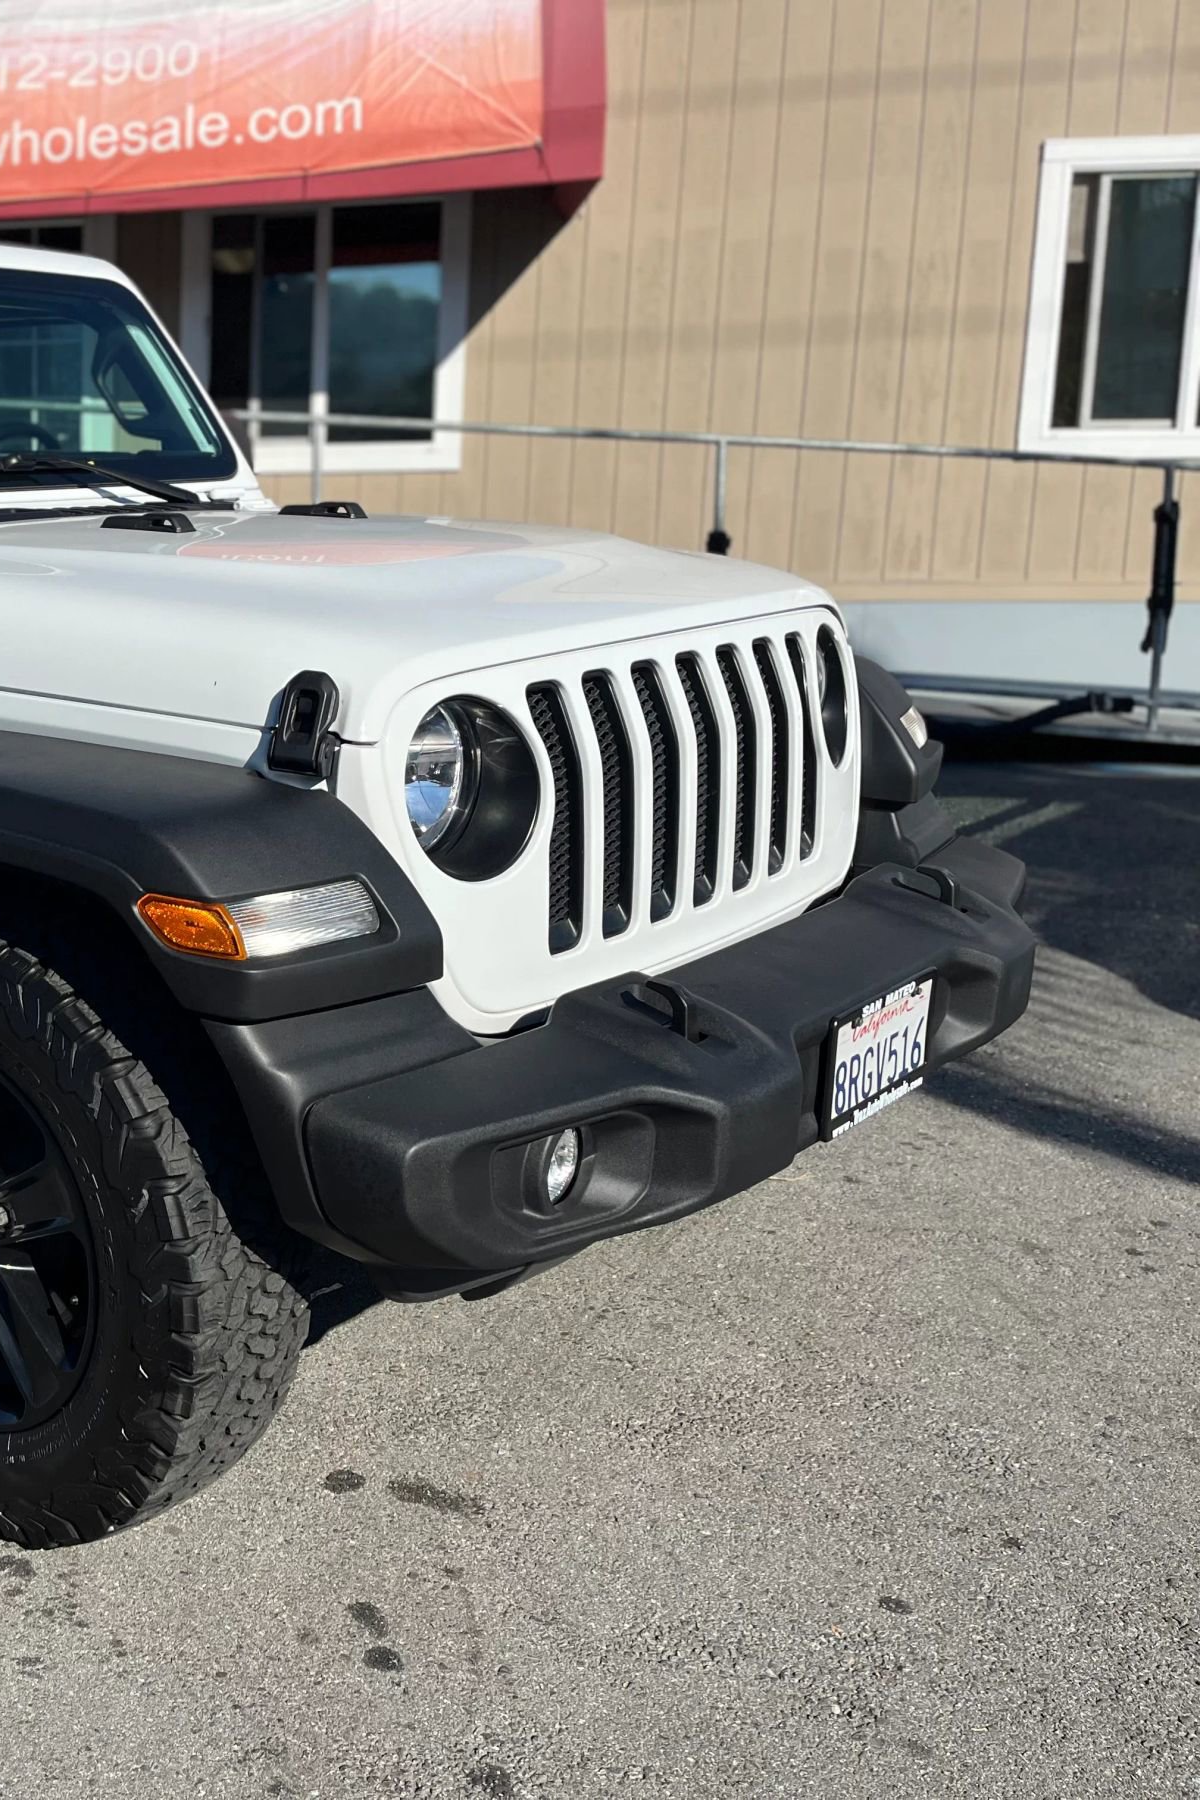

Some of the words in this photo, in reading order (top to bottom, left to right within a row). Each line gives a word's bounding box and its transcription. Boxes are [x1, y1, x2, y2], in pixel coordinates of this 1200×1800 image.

[861, 998, 883, 1018] SAN
[884, 980, 917, 1007] MATEO
[834, 1015, 925, 1116] 8RGV516
